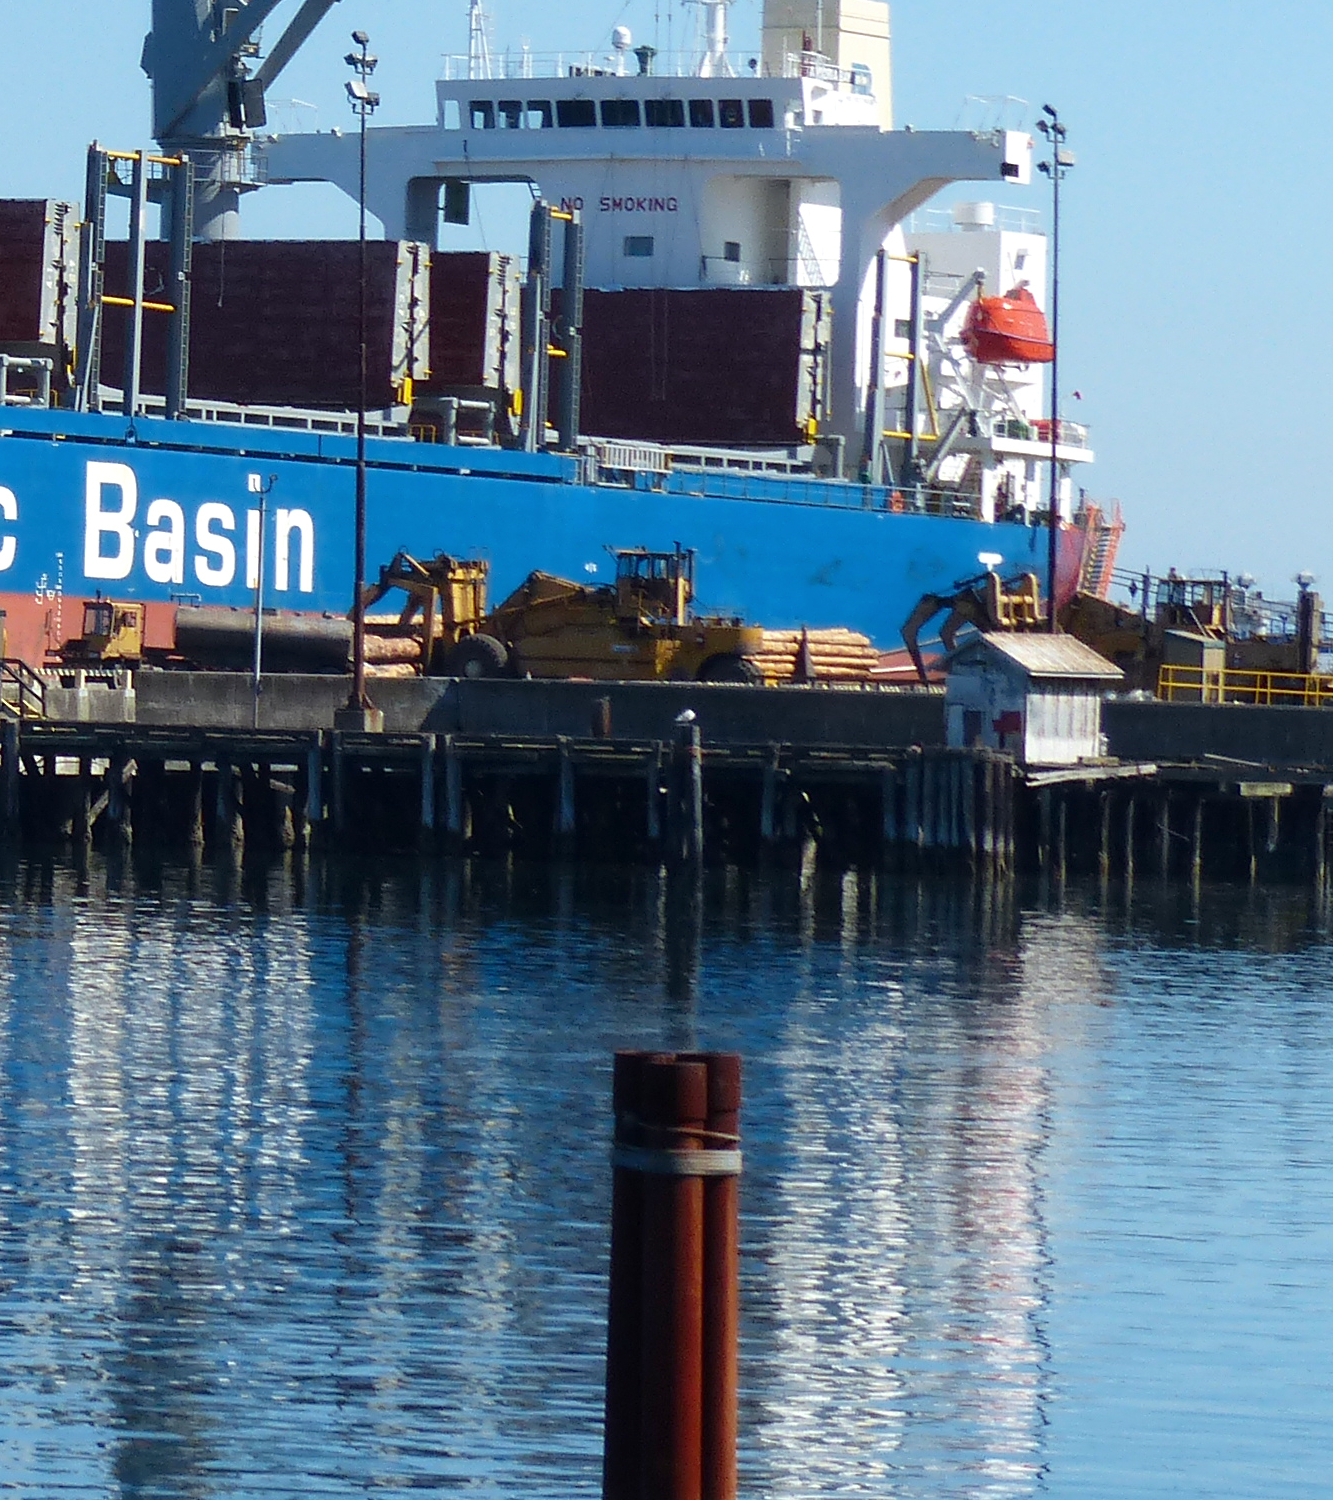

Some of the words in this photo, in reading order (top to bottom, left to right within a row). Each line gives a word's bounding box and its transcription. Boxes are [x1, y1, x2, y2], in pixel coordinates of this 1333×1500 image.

[561, 196, 584, 211] NO
[600, 197, 678, 212] SMOKING
[84, 461, 314, 593] Basin
